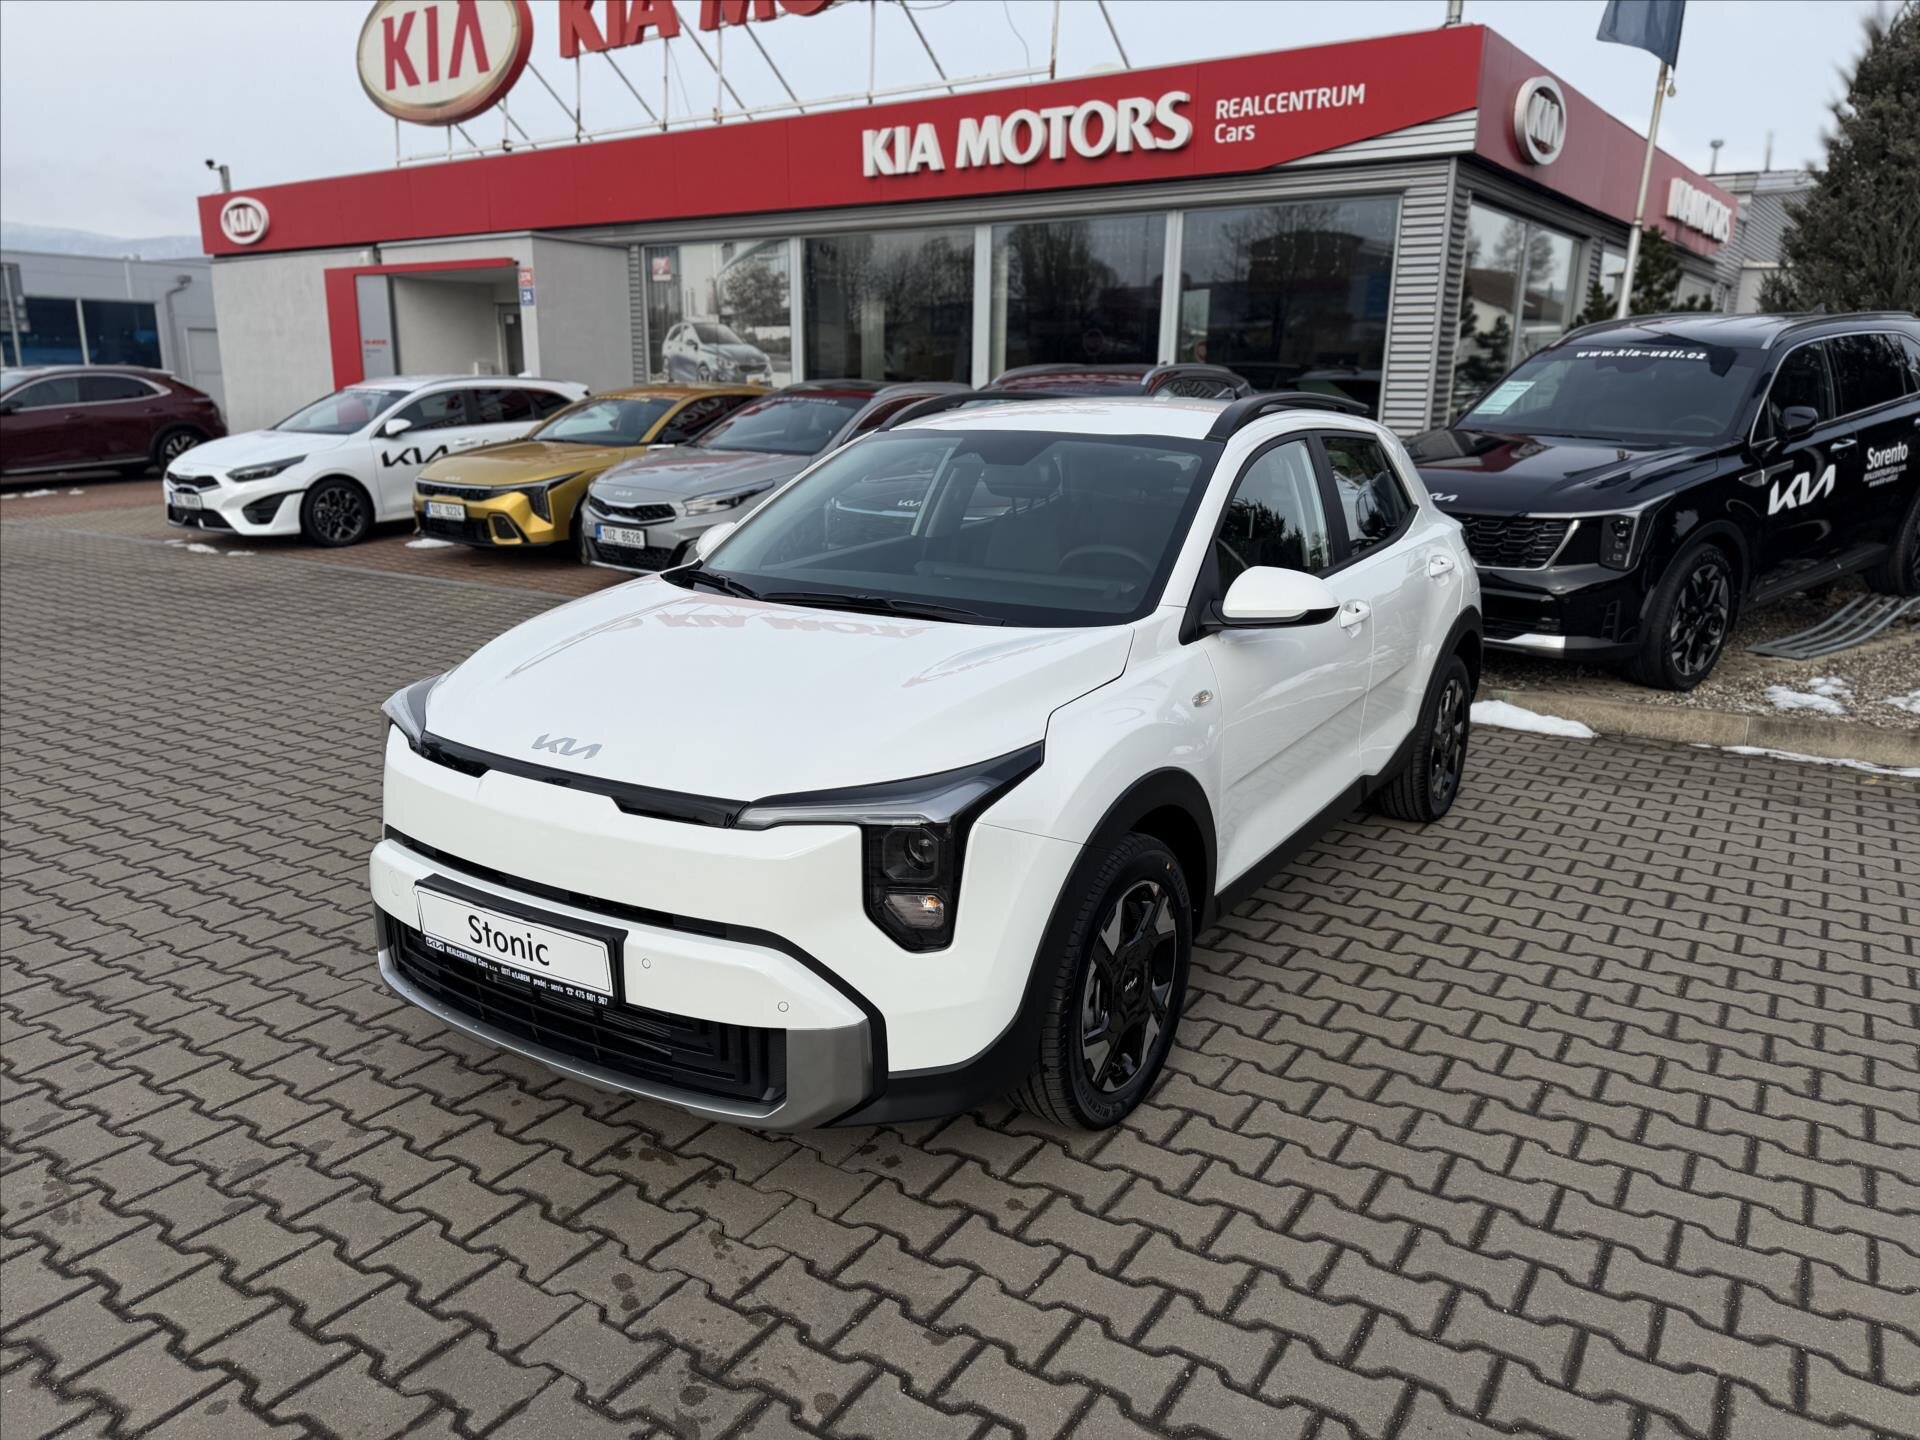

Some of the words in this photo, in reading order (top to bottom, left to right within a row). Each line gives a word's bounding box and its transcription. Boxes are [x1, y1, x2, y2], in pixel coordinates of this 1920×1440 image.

[382, 0, 490, 91] KIA
[1215, 83, 1366, 120] REALCENTRUM
[862, 122, 946, 177] KIA
[955, 90, 1193, 169] MOTORS
[1214, 123, 1256, 144] Cars
[228, 207, 258, 234] KIA
[1576, 348, 1707, 360] www.kia-usti.cz
[381, 445, 449, 468] KIA
[1866, 441, 1909, 470] Sorento
[1767, 463, 1836, 516] KIA
[531, 733, 602, 760] KIA
[468, 914, 550, 966] Stonic
[478, 958, 488, 969] Cars
[575, 988, 585, 999] 475
